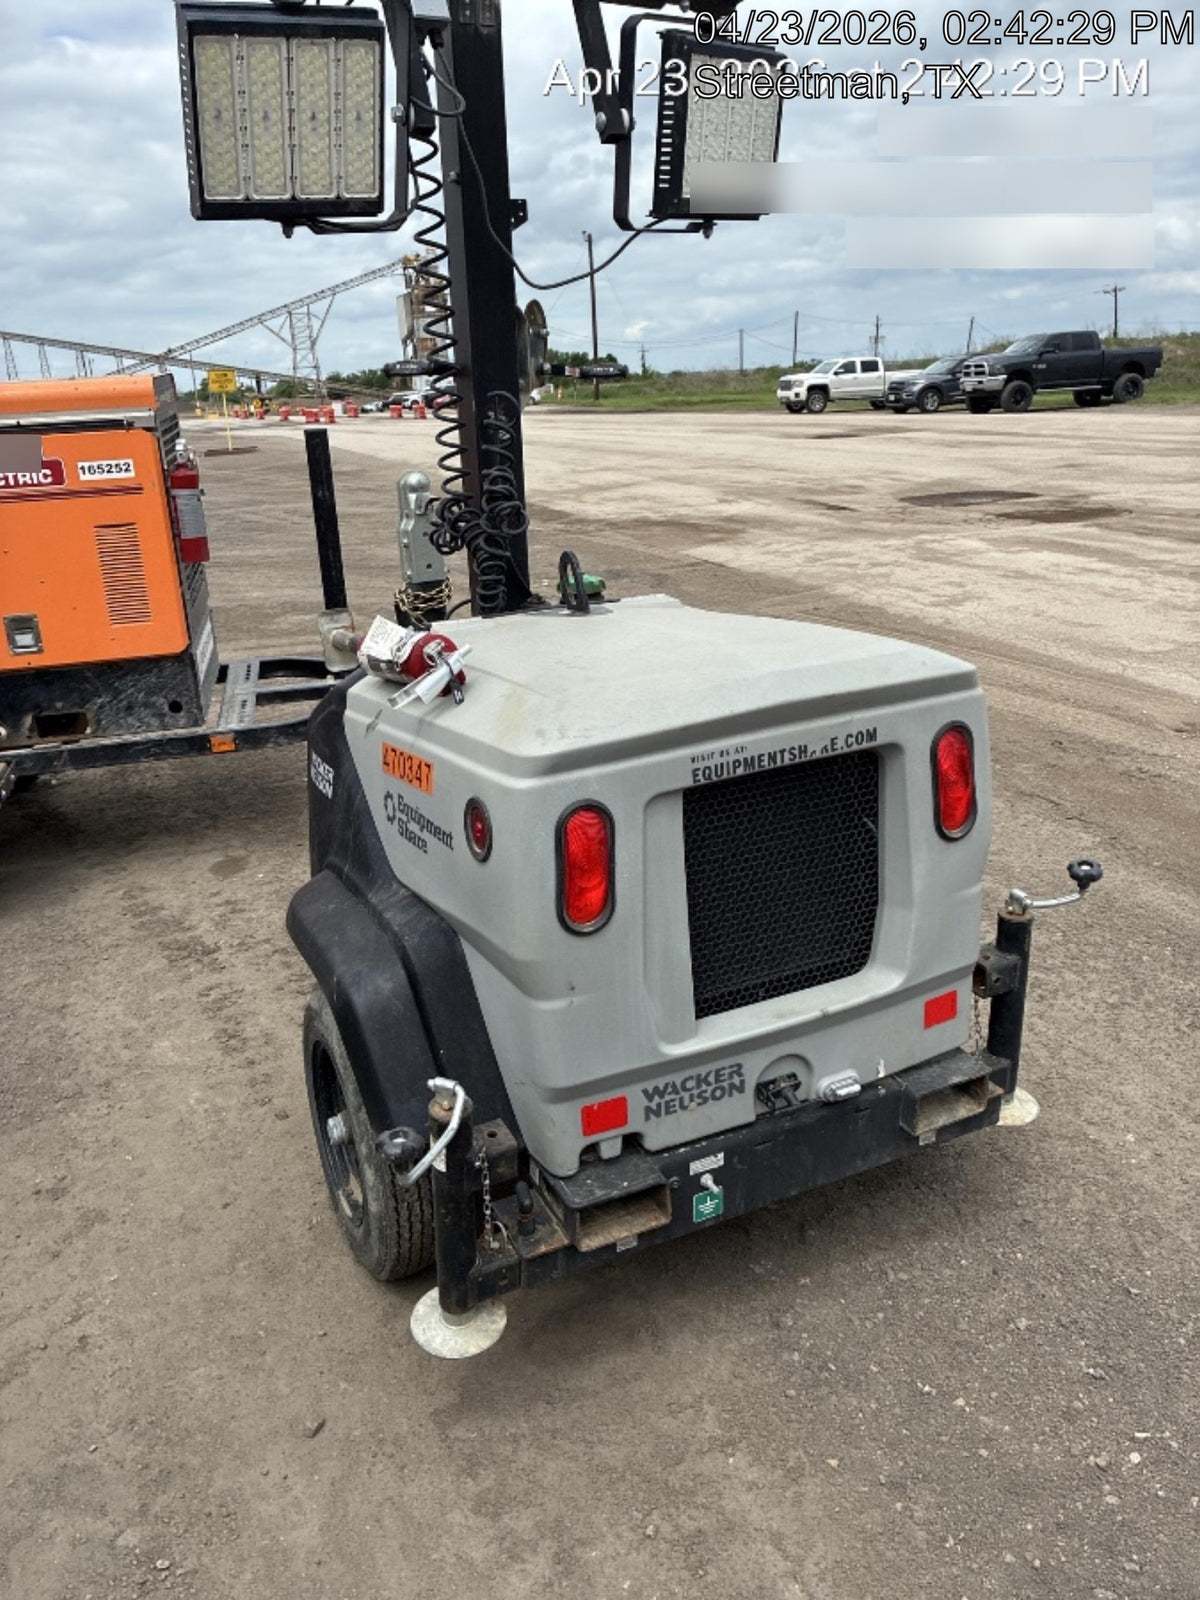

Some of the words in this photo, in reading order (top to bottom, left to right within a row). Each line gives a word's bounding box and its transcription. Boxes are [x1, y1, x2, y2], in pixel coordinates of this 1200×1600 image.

[79, 461, 133, 476] 165252
[383, 746, 432, 793] 470347
[397, 793, 455, 852] Equipment
[397, 816, 428, 854] Share
[641, 1062, 744, 1103] WACKER
[644, 1079, 745, 1122] NEUSON
